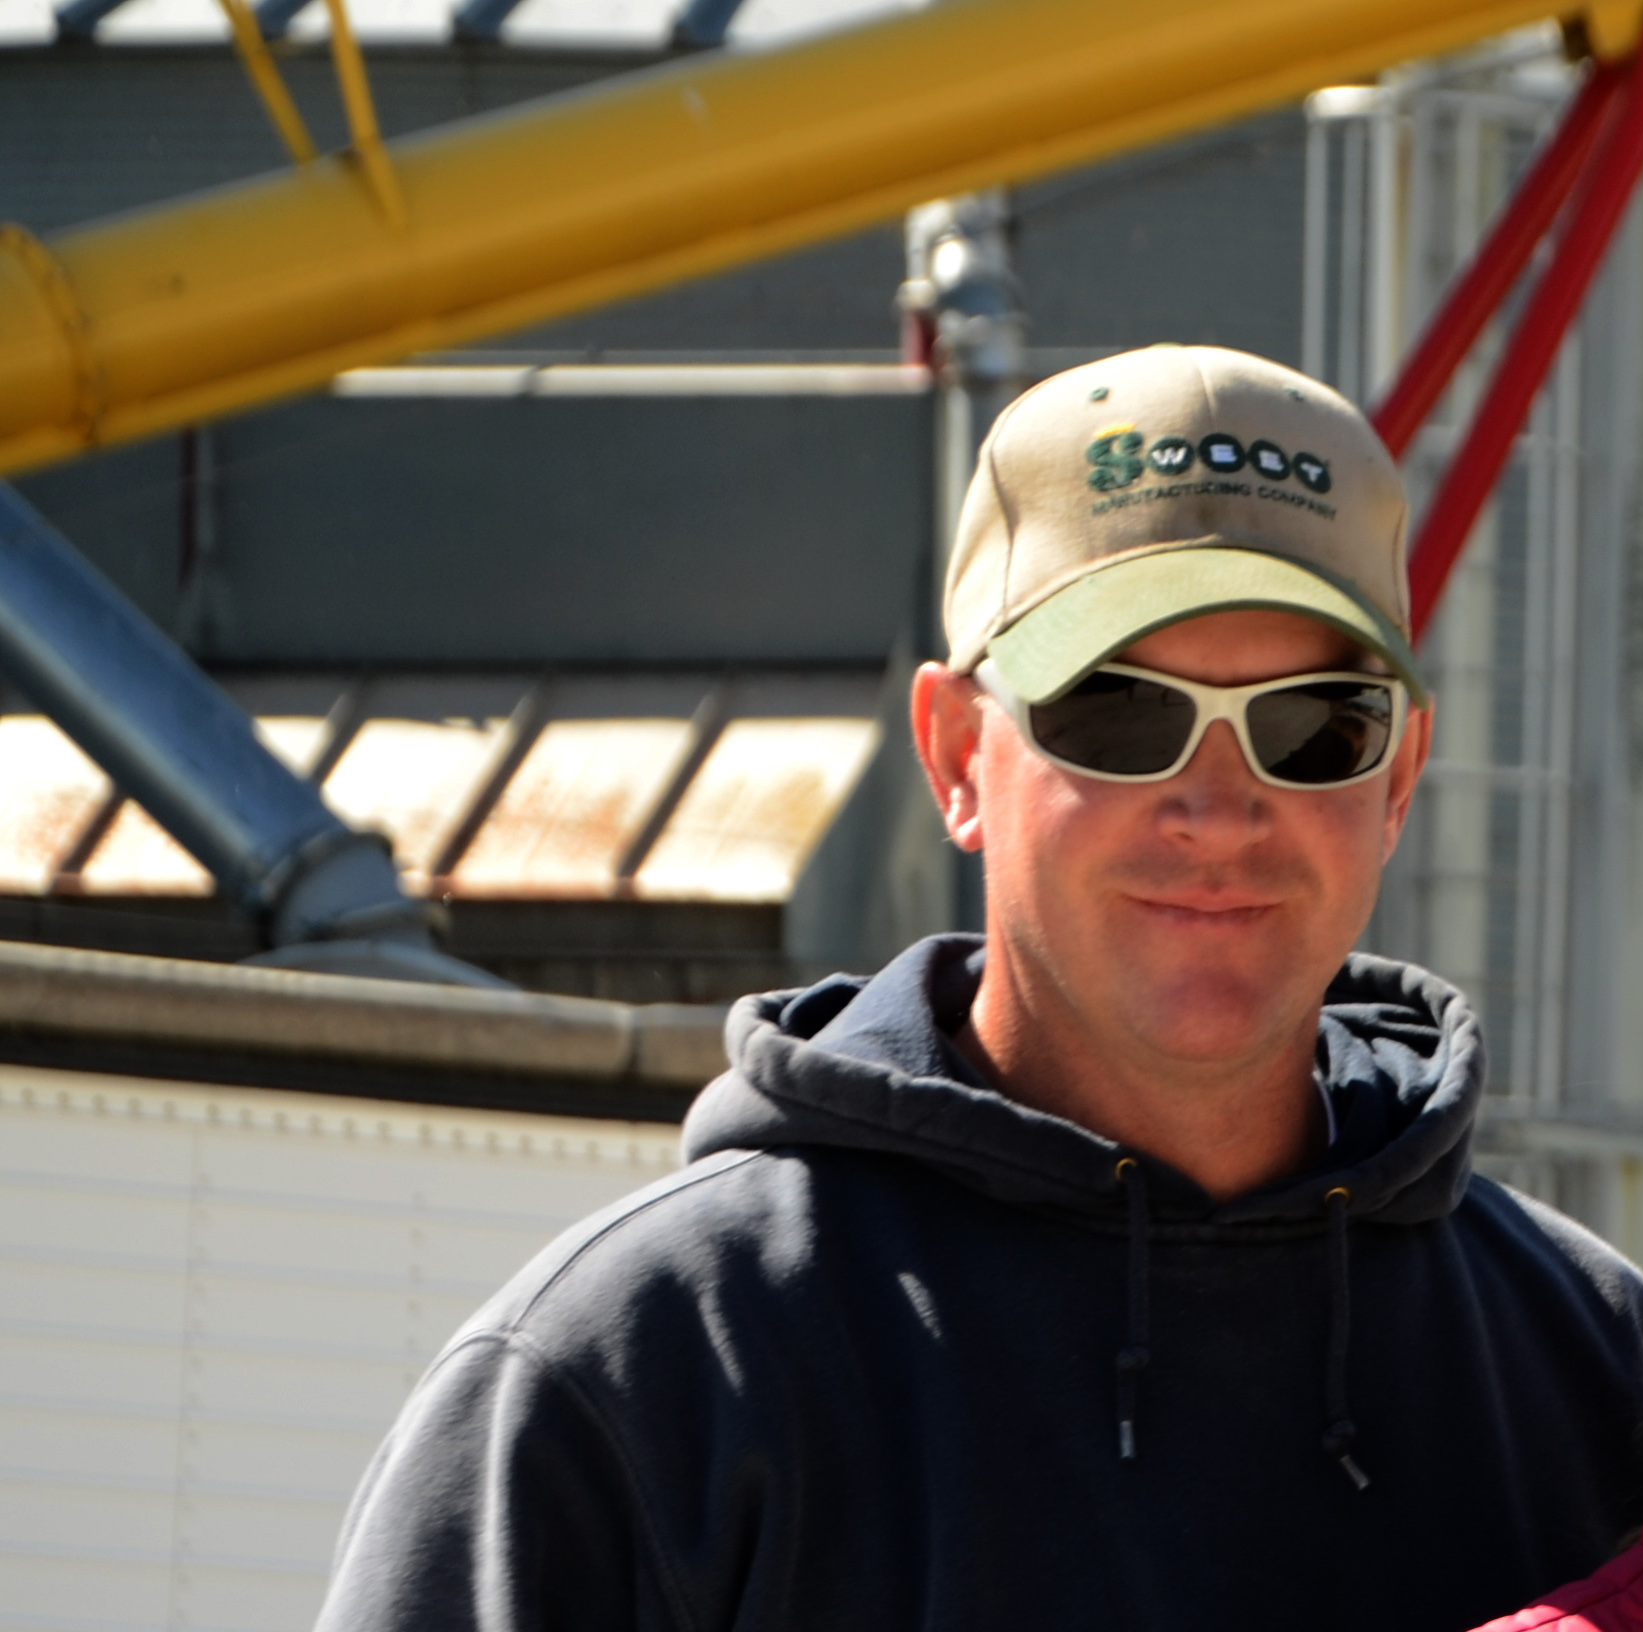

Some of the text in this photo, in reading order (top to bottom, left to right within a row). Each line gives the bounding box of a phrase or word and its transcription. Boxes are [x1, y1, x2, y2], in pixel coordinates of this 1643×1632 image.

[1086, 431, 1332, 492] SWEET
[1091, 481, 1336, 520] MANUFACTURING COMPANY
